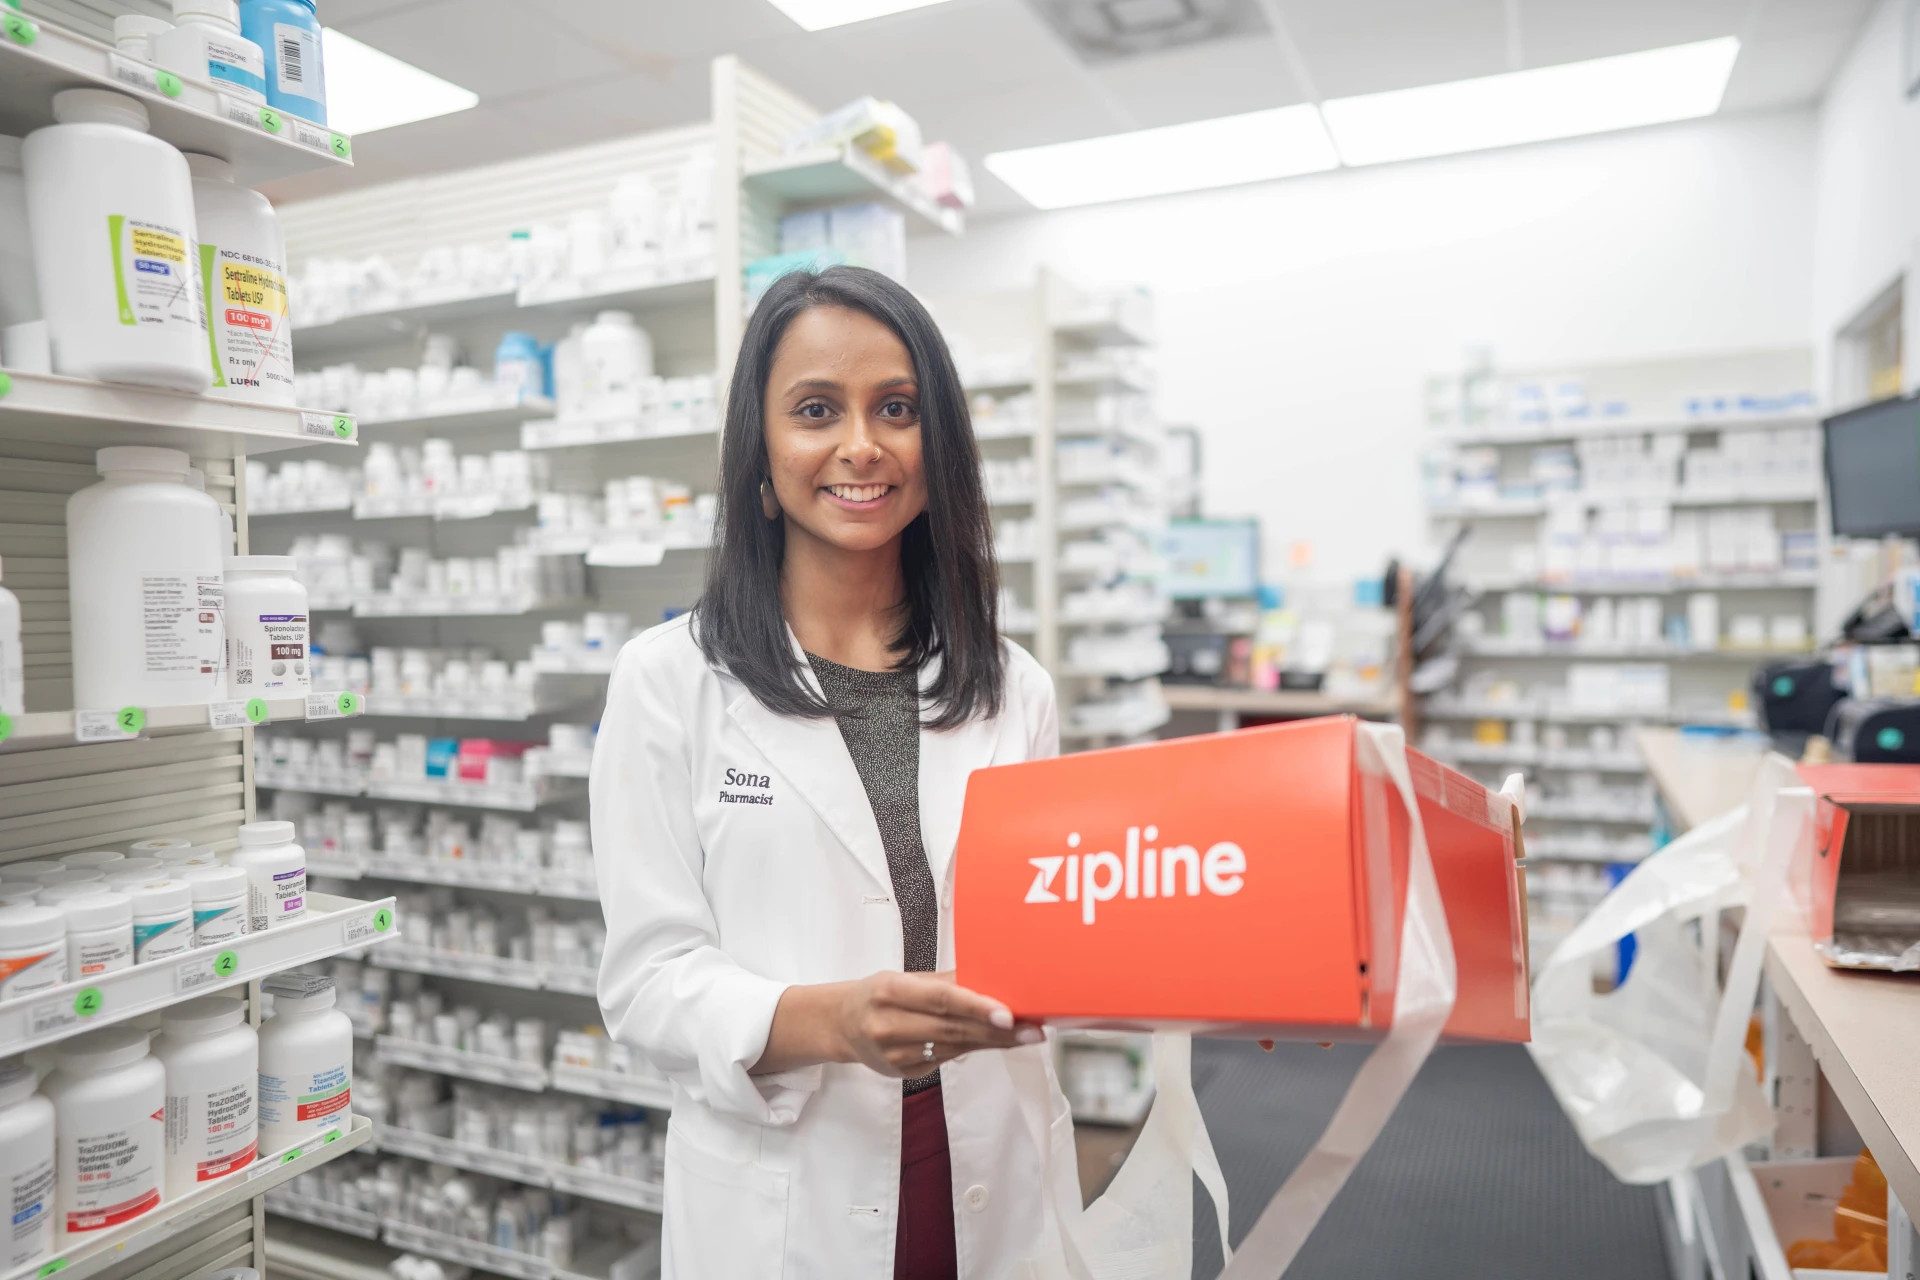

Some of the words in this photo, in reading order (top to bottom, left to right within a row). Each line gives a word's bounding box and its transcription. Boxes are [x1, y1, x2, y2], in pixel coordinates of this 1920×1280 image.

[264, 113, 275, 127] 2
[336, 138, 345, 152] 2
[134, 230, 175, 243] Sertraline
[221, 250, 240, 260] NDC
[225, 267, 258, 285] Sertraline
[226, 287, 251, 302] Tablets
[252, 291, 264, 304] USP
[230, 312, 250, 322] 100
[229, 356, 240, 365] Rx
[242, 359, 257, 368] only
[230, 377, 260, 387] LUPIN
[266, 372, 281, 381] 5000
[339, 419, 346, 432] 2
[269, 634, 294, 642] Tablets,
[294, 633, 304, 641] USP
[276, 646, 290, 656] 100
[291, 648, 302, 657] mg
[343, 698, 351, 709] 3
[124, 712, 135, 727] 2
[724, 768, 770, 789] Sona
[718, 791, 774, 805] Pharmacist
[1024, 825, 1247, 926] zipline
[222, 957, 232, 969] 2
[83, 995, 96, 1010] 2
[208, 1090, 247, 1109] TraZODONE
[208, 1097, 252, 1117] Hydrochloride
[208, 1113, 237, 1125] Tablets,
